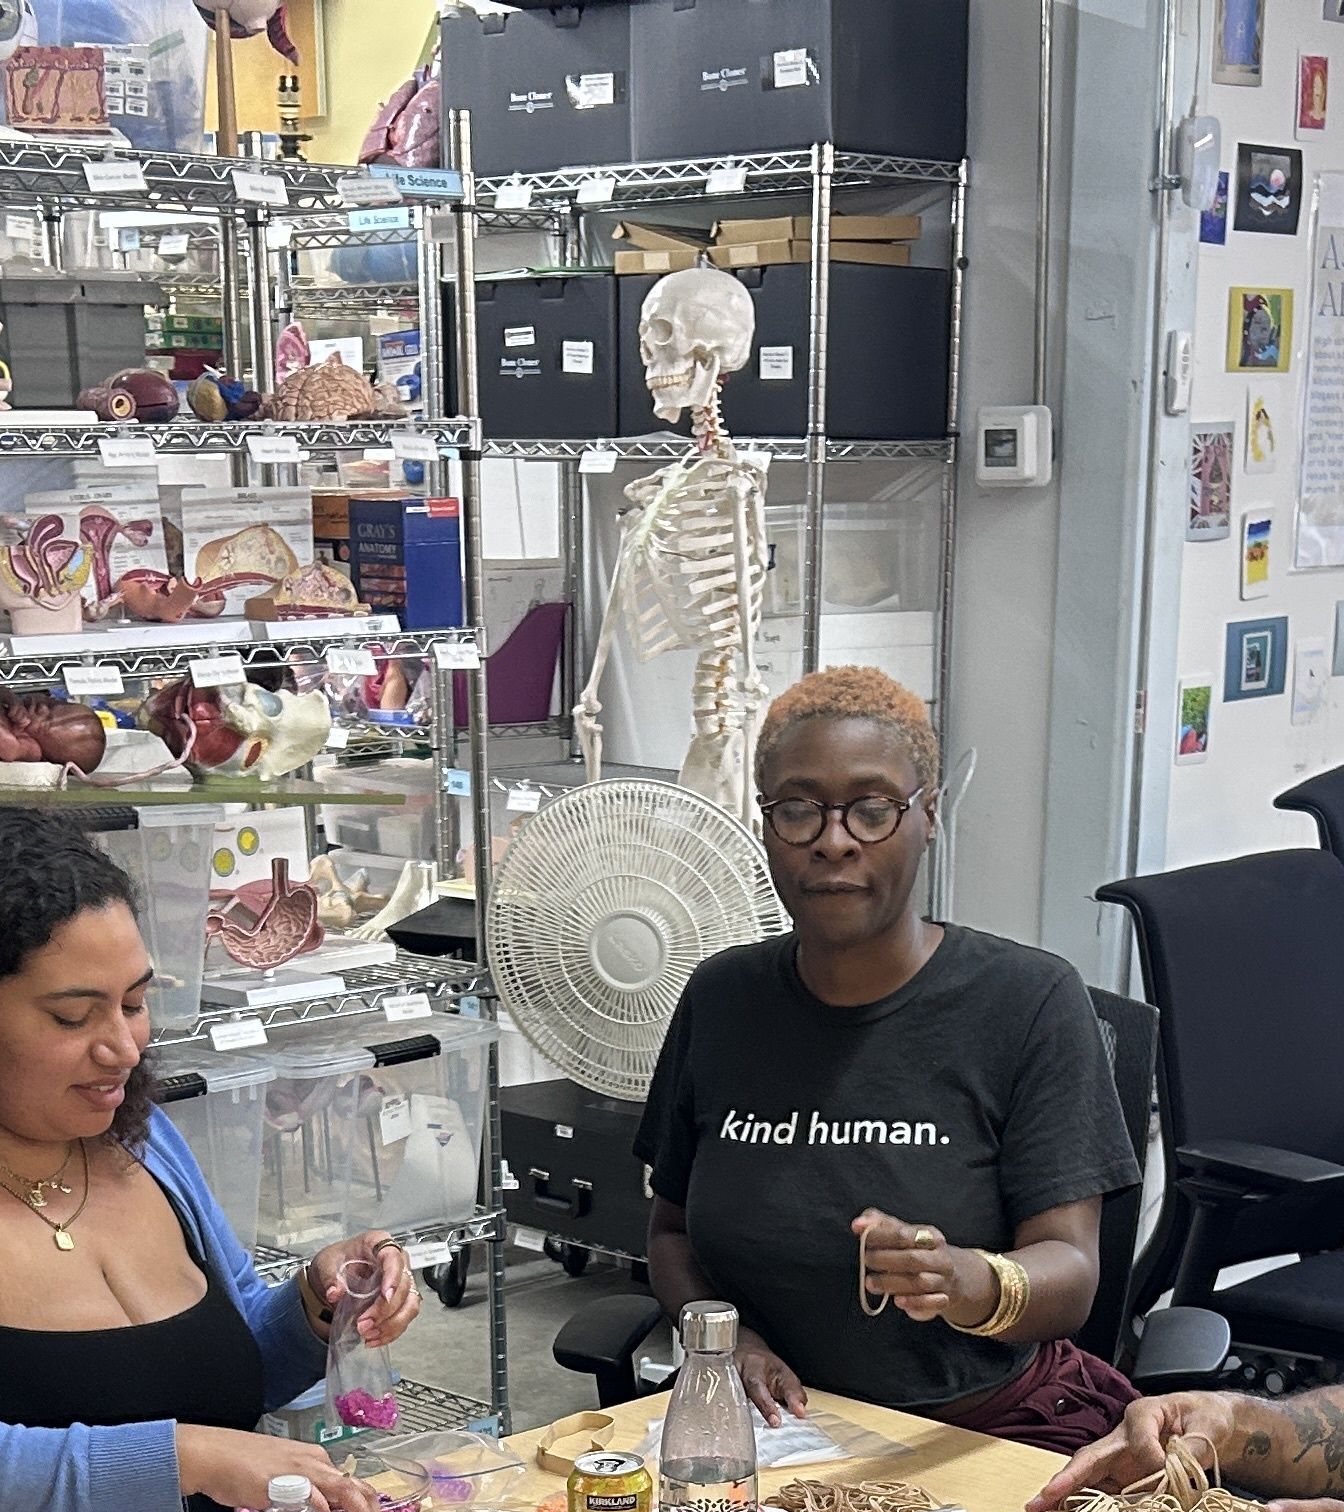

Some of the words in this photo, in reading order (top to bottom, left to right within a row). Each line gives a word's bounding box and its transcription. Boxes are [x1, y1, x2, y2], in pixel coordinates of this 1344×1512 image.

[408, 174, 448, 189] Science
[357, 522, 396, 539] GRAY'S
[358, 542, 397, 554] ANATOMY
[719, 1110, 797, 1146] kind
[808, 1111, 952, 1147] human.
[588, 1496, 636, 1506] KIRKLAND
